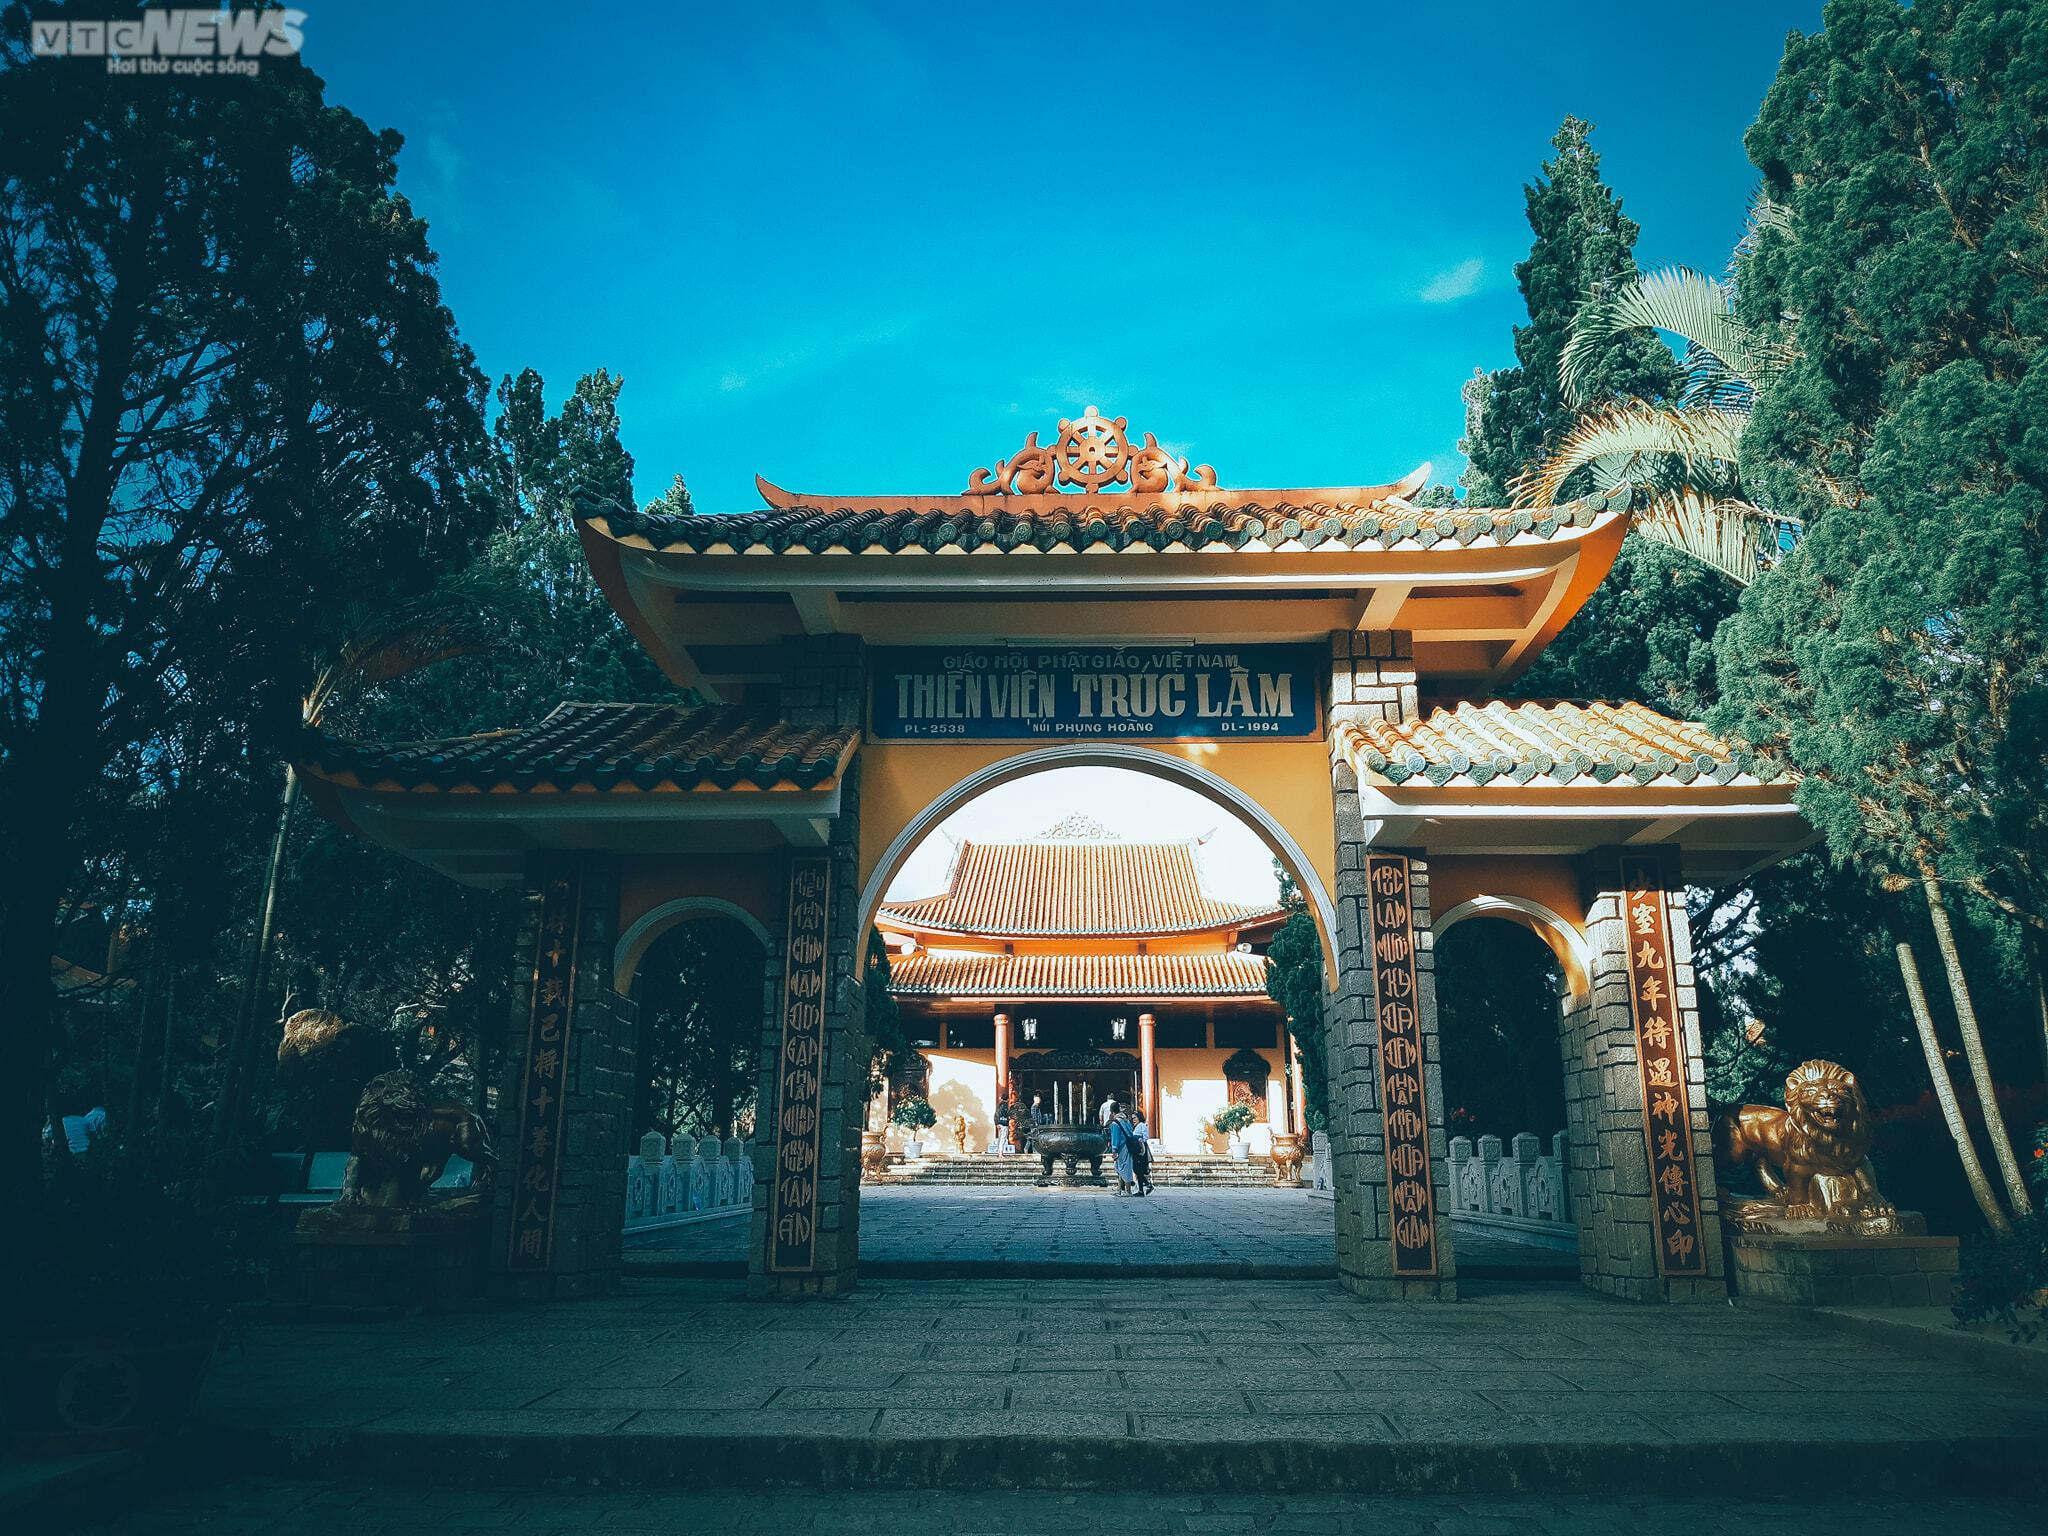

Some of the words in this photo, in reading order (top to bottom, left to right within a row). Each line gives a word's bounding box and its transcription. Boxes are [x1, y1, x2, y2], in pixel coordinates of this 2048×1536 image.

[943, 651, 988, 669] GIÁO
[995, 651, 1029, 672] HỘI
[1038, 651, 1088, 672] PHẬT
[1089, 650, 1140, 669] GIÁO
[1152, 651, 1198, 672] VIỆT
[1198, 654, 1239, 668] NAM
[895, 668, 982, 718] THIỀN
[988, 669, 1056, 725] VIỆN
[1073, 660, 1187, 718] TRÚC
[1195, 666, 1294, 718] LÂM
[904, 723, 966, 734] PL-2538
[1032, 718, 1050, 733] NÚI
[1056, 723, 1102, 736] PHỤNG
[1108, 718, 1154, 732] HOÀNG
[1221, 722, 1279, 732] DL-1994
